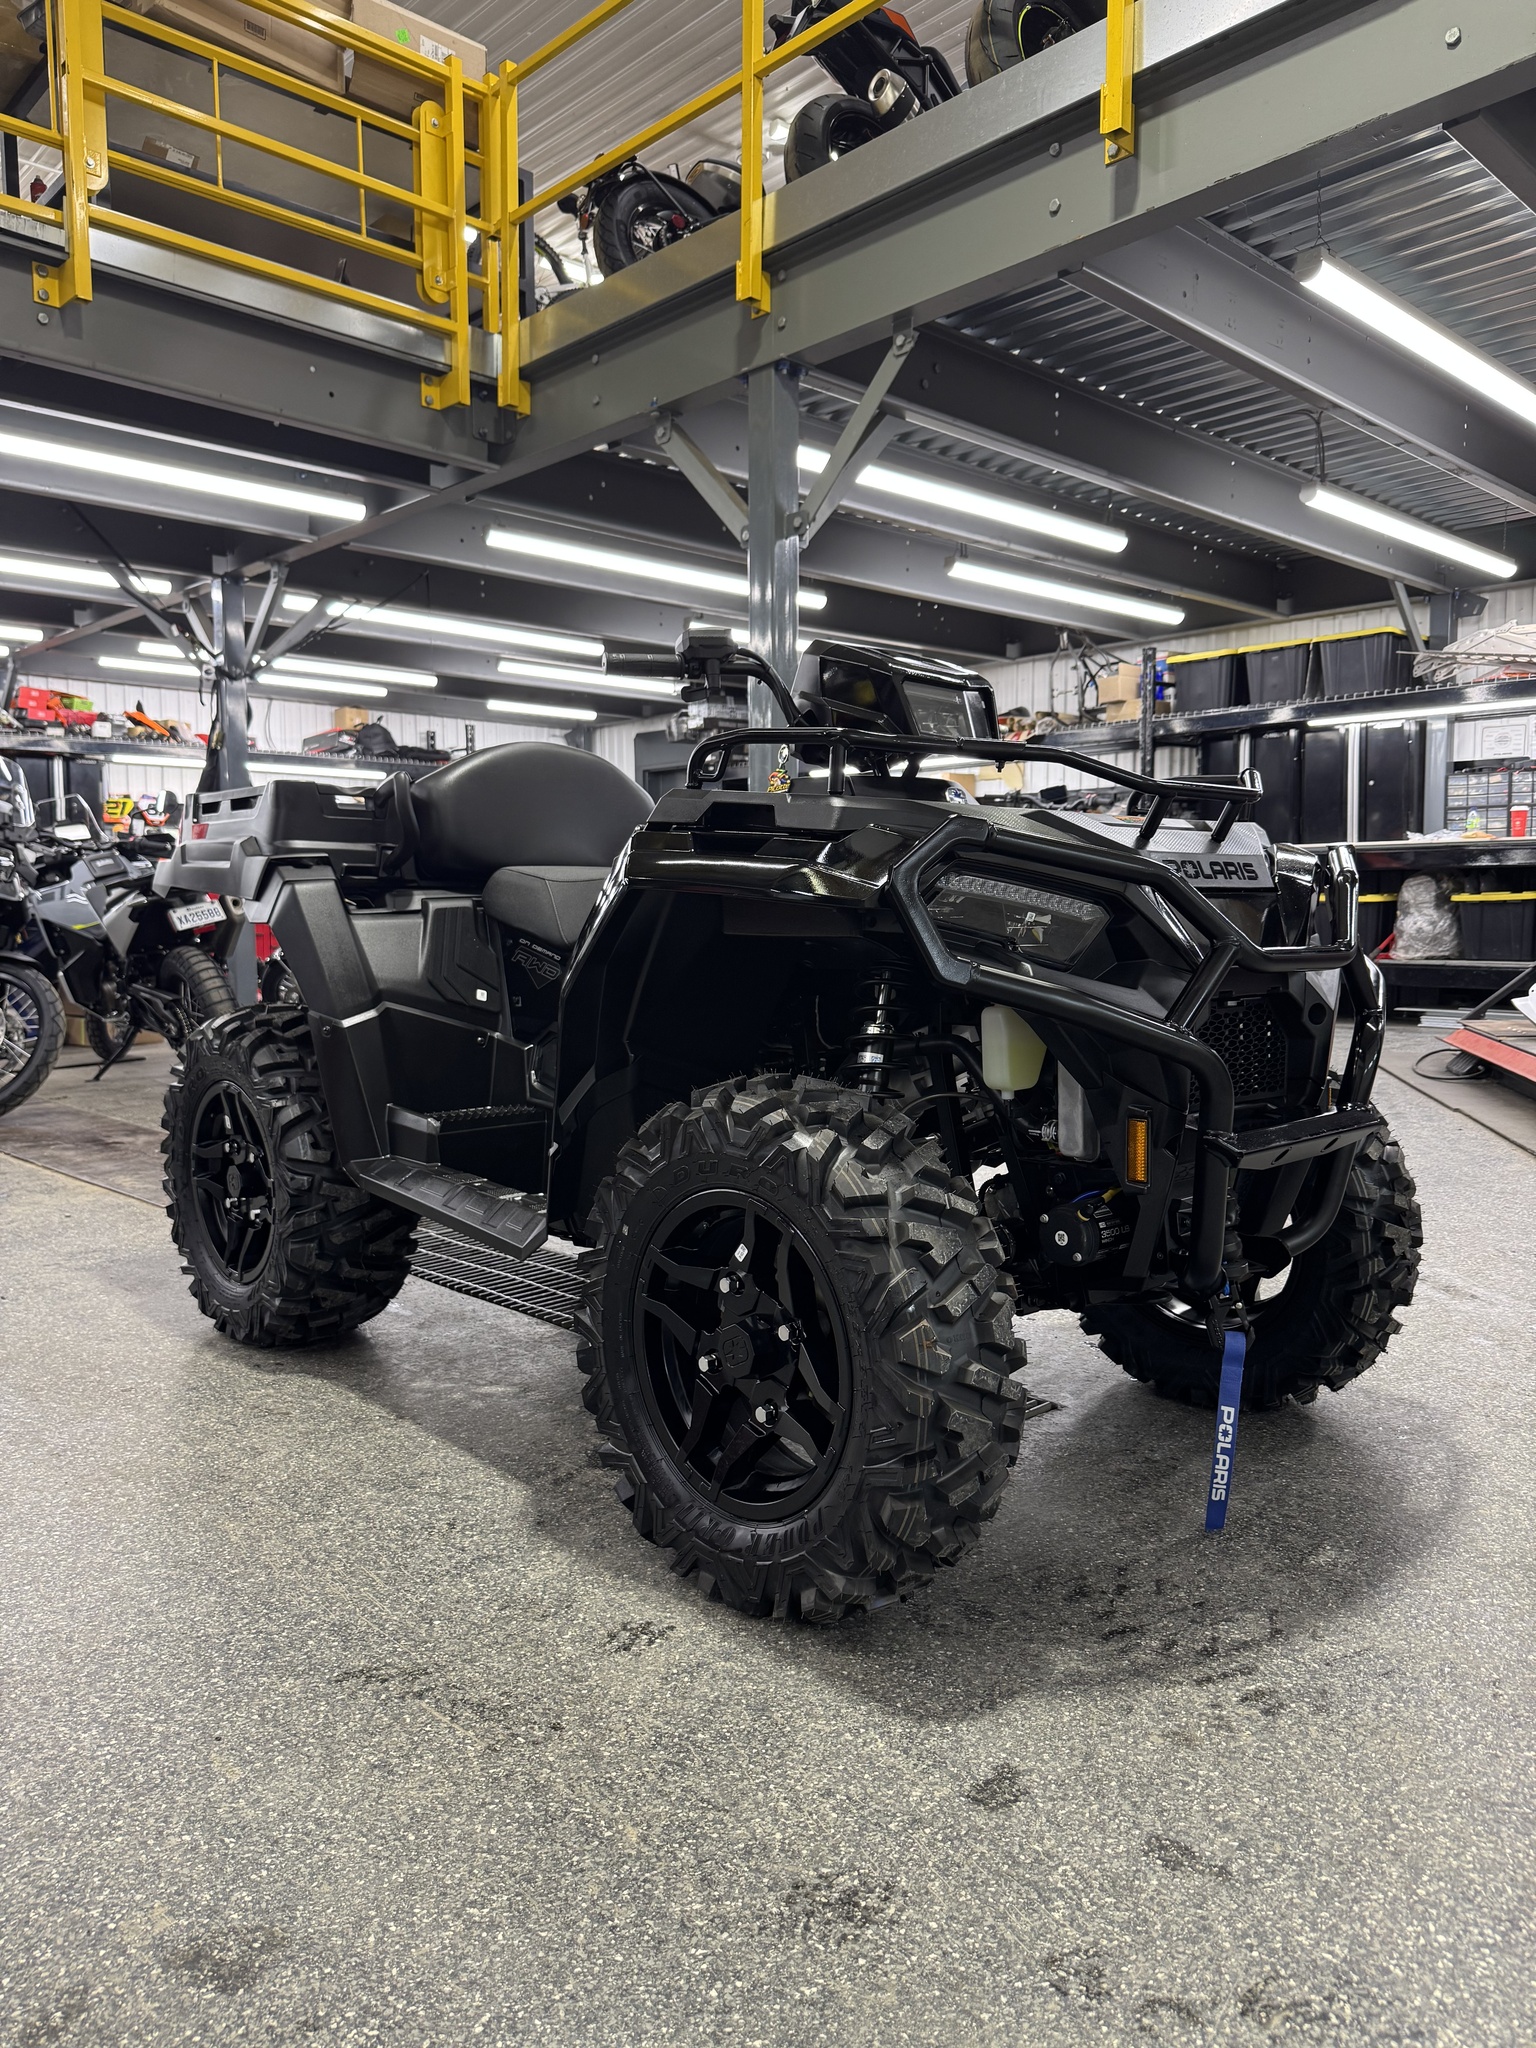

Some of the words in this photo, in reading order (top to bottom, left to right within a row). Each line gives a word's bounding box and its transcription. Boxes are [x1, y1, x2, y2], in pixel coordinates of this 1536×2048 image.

[511, 949, 561, 981] AWD
[1100, 1227, 1120, 1239] 3500
[1211, 1405, 1236, 1502] POLARIS
